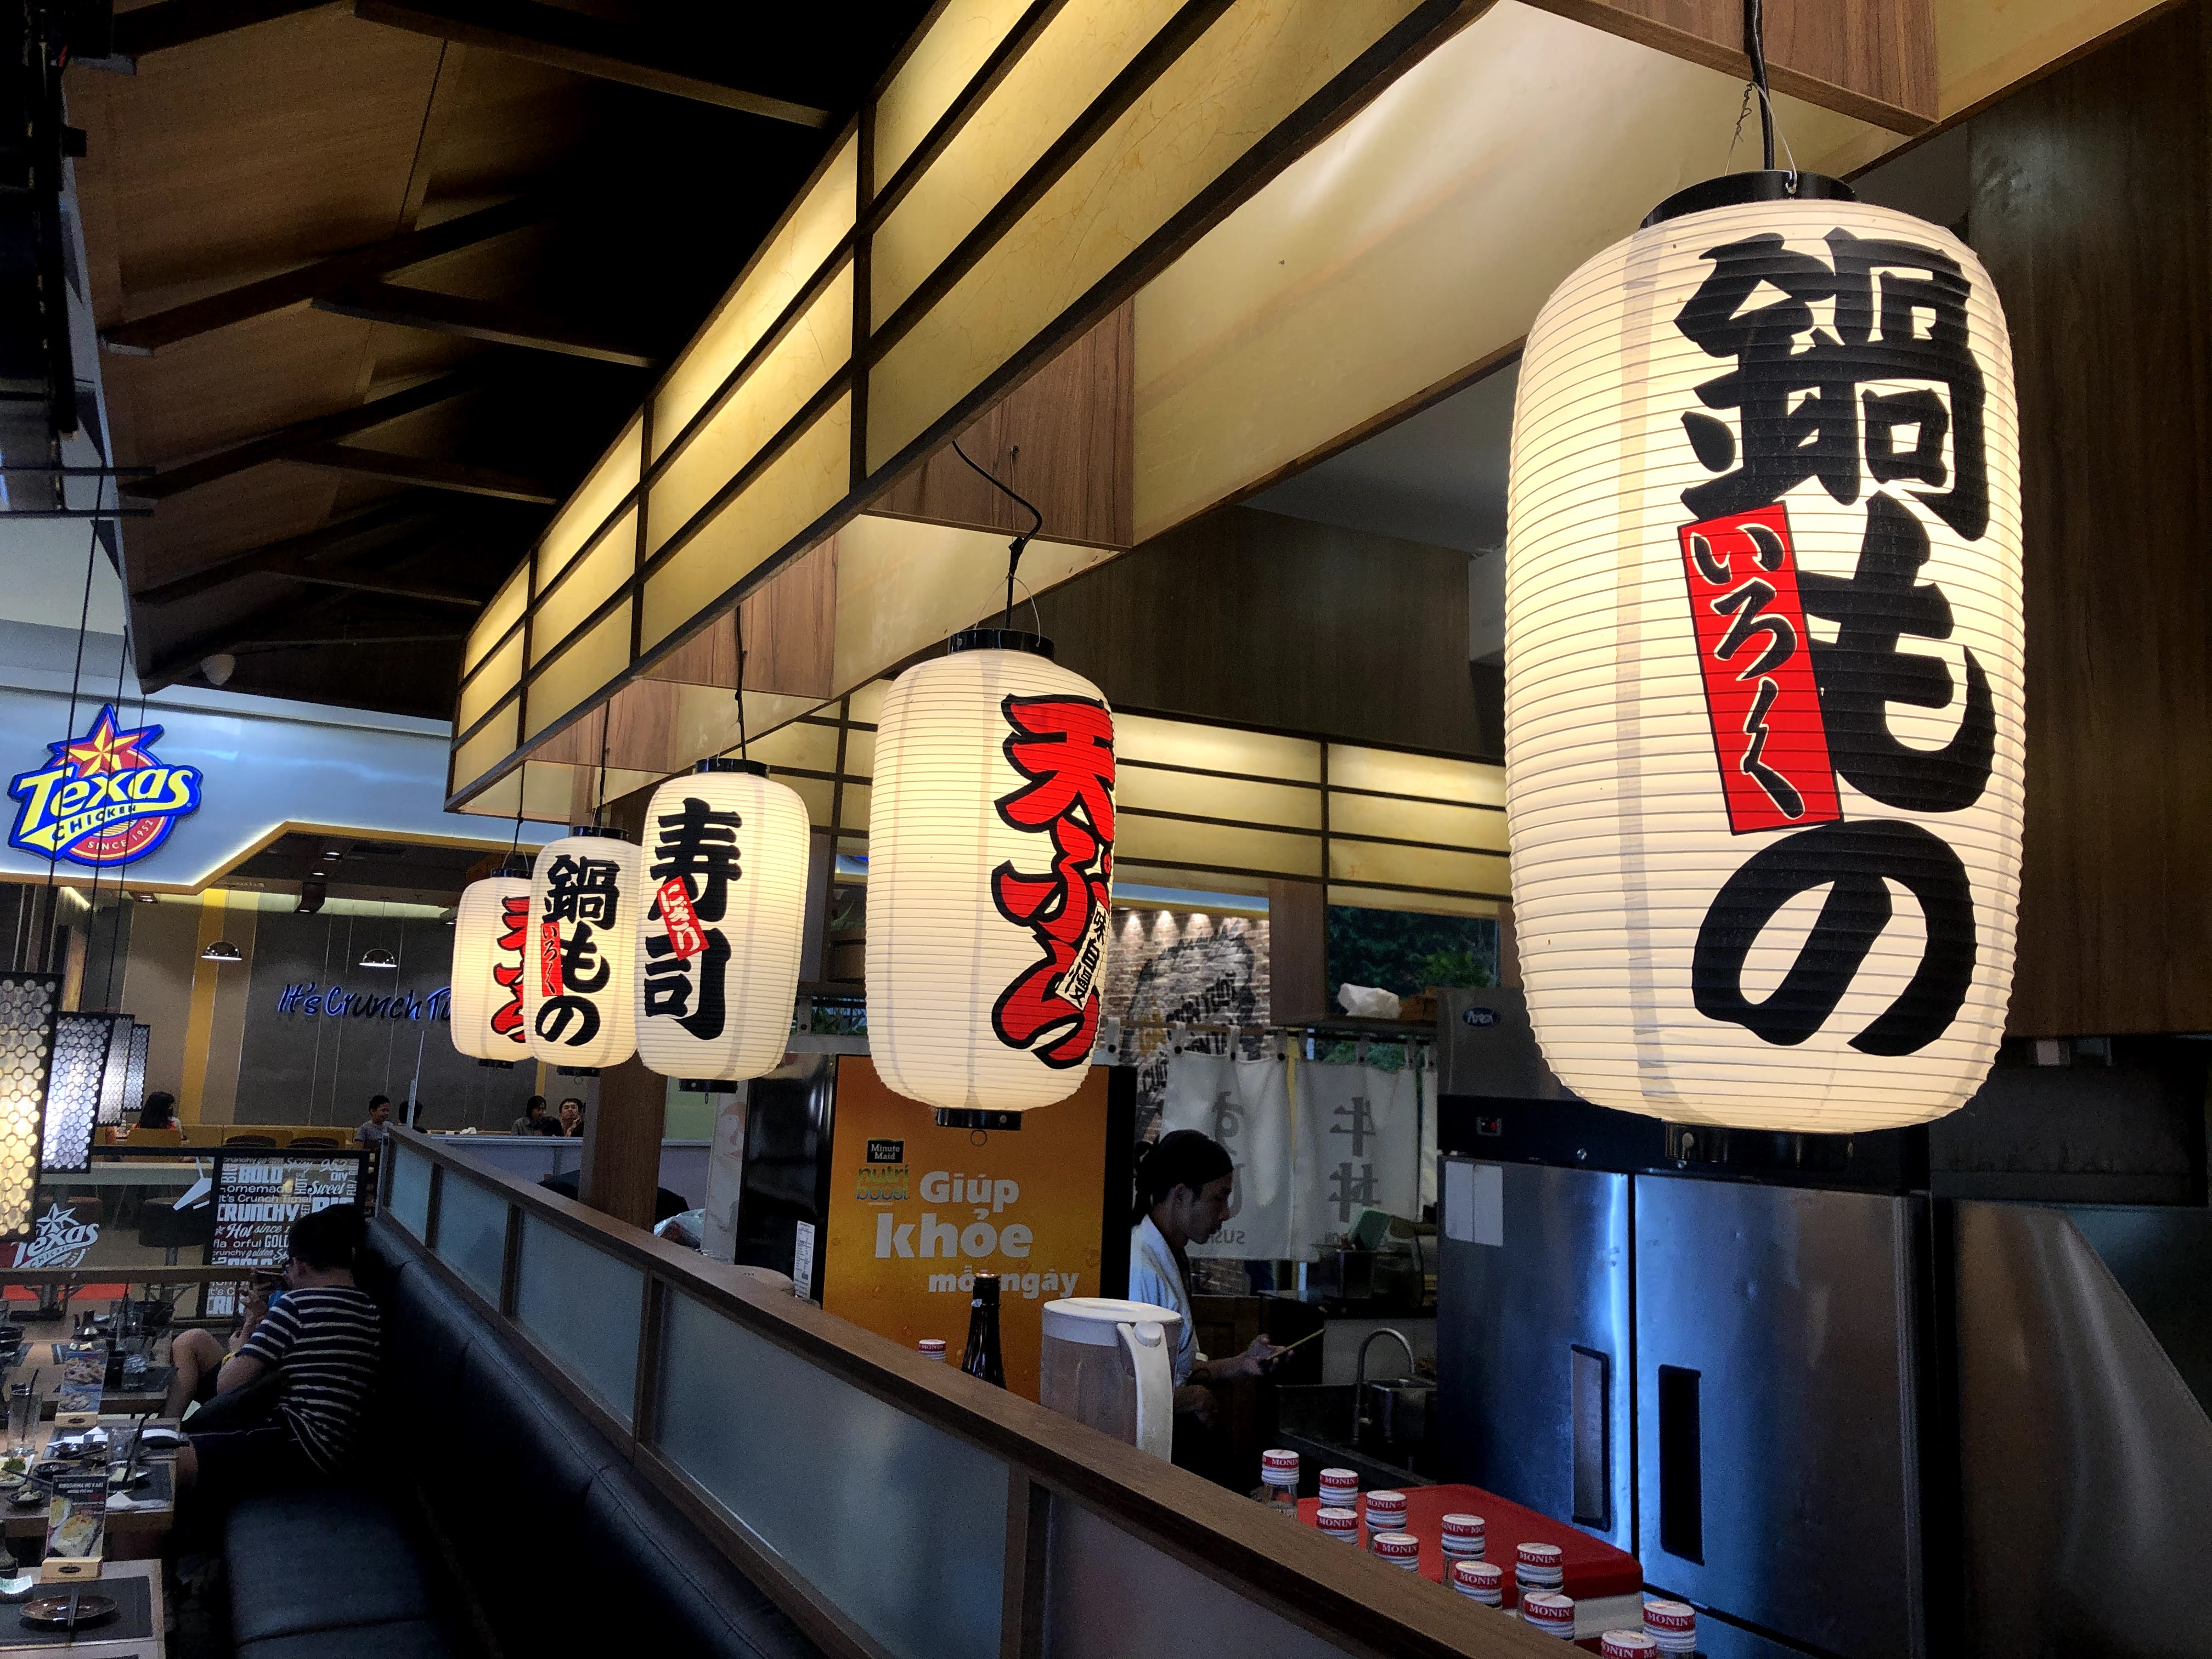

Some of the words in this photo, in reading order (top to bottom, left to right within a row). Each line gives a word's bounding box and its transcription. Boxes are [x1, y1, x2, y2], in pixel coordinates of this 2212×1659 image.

[1674, 229, 1997, 1057] 鍋もの
[17, 767, 193, 836] Texas
[52, 805, 137, 840] CHICKEN
[87, 840, 127, 850] SINCE
[132, 820, 154, 840] 1952
[644, 797, 742, 1041] 寿司
[662, 884, 701, 952] にぎり
[535, 854, 620, 1046] 鍋もの
[279, 982, 322, 1015] It's
[325, 986, 422, 1021] Crunch
[871, 1144, 900, 1152] Minute
[874, 1152, 895, 1160] Maid
[238, 1166, 284, 1183] BOLD
[307, 1181, 346, 1195] Sweet
[920, 1171, 1020, 1212] Giúp
[238, 1194, 279, 1203] Crunch
[217, 1204, 300, 1222] CRUNCHY
[225, 1223, 255, 1239] Hot
[876, 1209, 1034, 1258] khỏe
[928, 1265, 981, 1293] mỗ
[1002, 1268, 1080, 1299] ngày
[1324, 1476, 1356, 1485] MONIN
[1319, 1518, 1353, 1527] MONIN
[1382, 1543, 1417, 1554] MONIN
[1520, 1552, 1556, 1564] MONIN
[1459, 1573, 1498, 1586] MONIN
[1529, 1604, 1571, 1618] MONIN
[1646, 1611, 1689, 1627] MONIN
